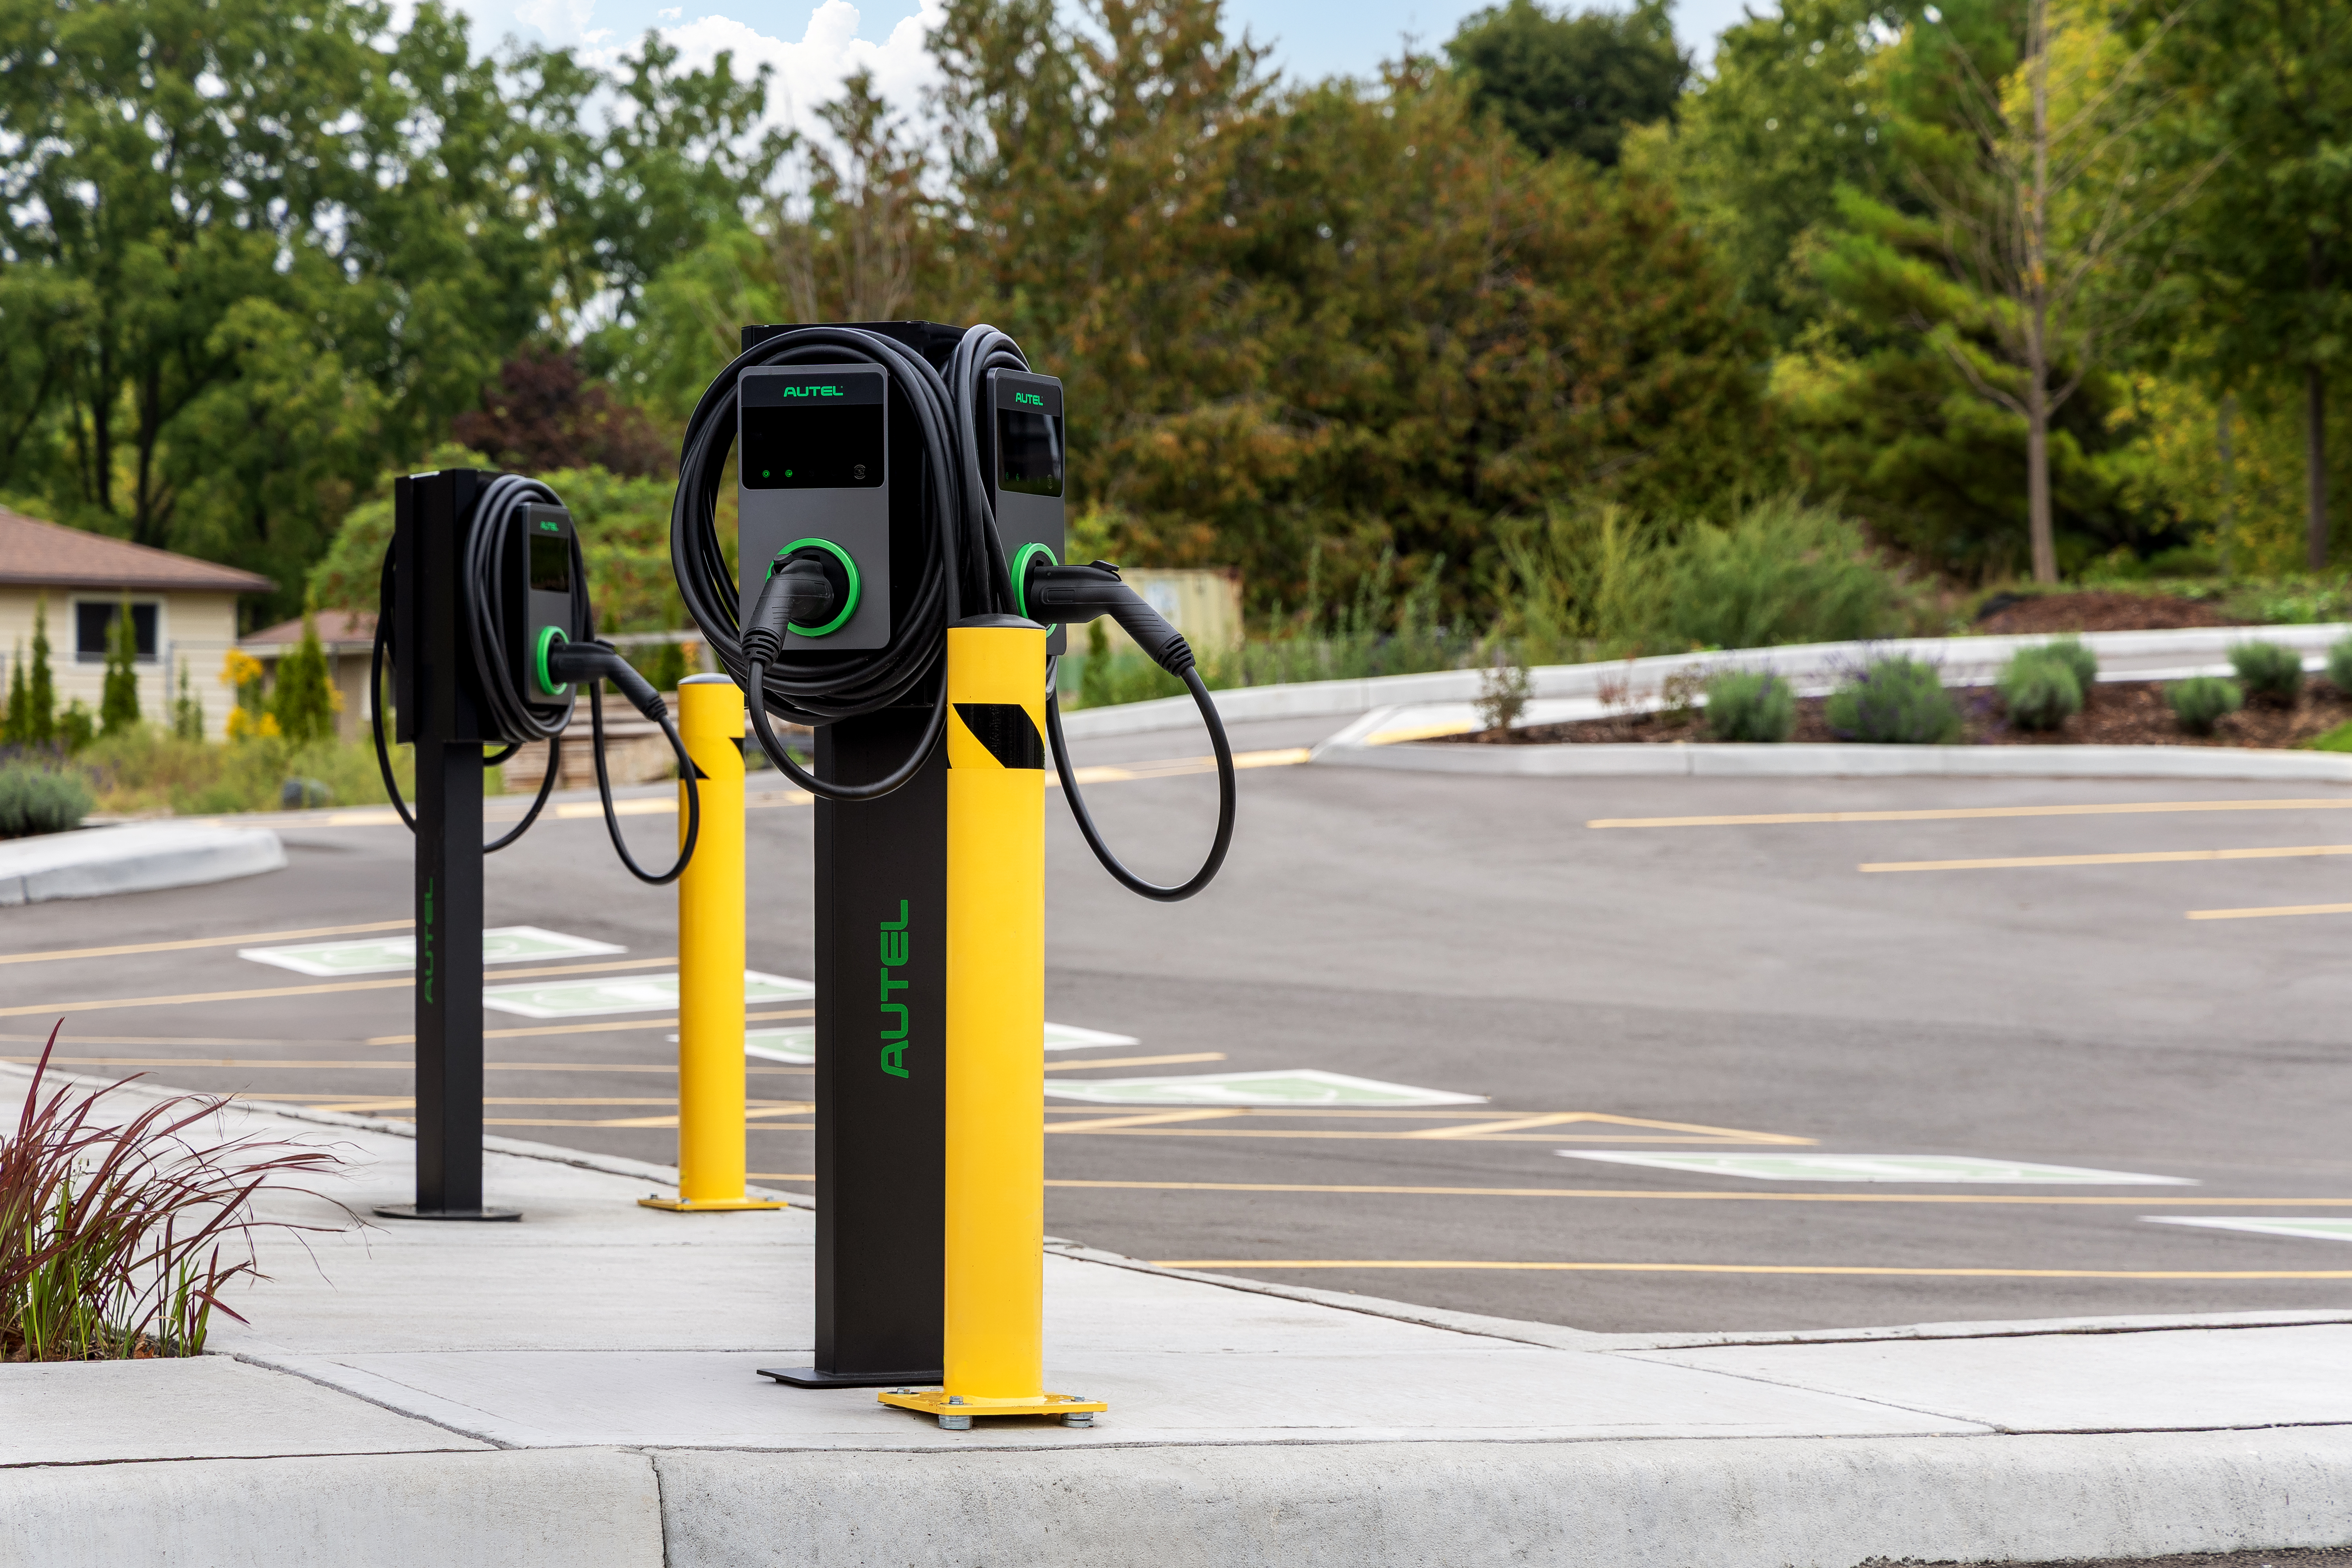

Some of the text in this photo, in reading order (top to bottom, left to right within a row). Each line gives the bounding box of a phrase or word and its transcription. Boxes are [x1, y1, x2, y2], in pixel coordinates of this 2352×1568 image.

[784, 386, 843, 397] AUTEL
[1015, 392, 1043, 406] AUTEL
[424, 877, 434, 1004] AUTEL
[880, 899, 909, 1079] AUTEL
